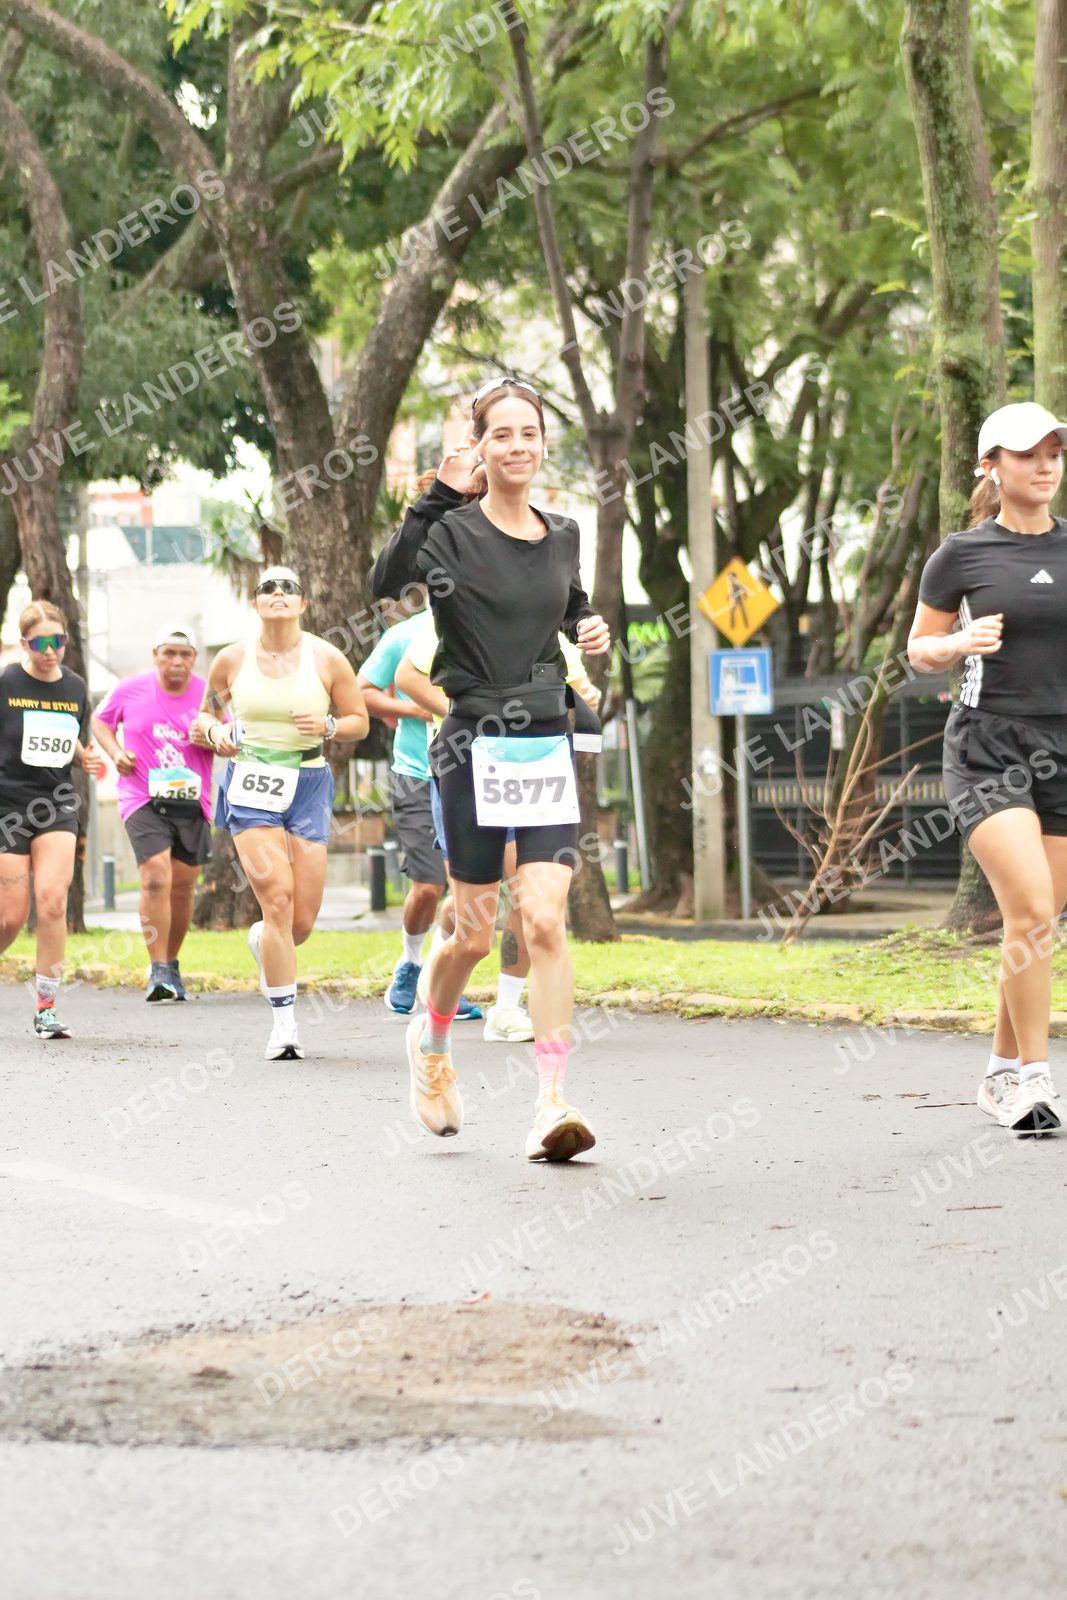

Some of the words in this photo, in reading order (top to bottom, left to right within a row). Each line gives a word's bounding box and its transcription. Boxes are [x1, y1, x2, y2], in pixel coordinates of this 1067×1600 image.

[8, 697, 40, 709] HARRY
[52, 701, 79, 712] STYLES
[28, 736, 72, 754] 5580
[242, 773, 285, 797] 652
[483, 776, 567, 805] 5877
